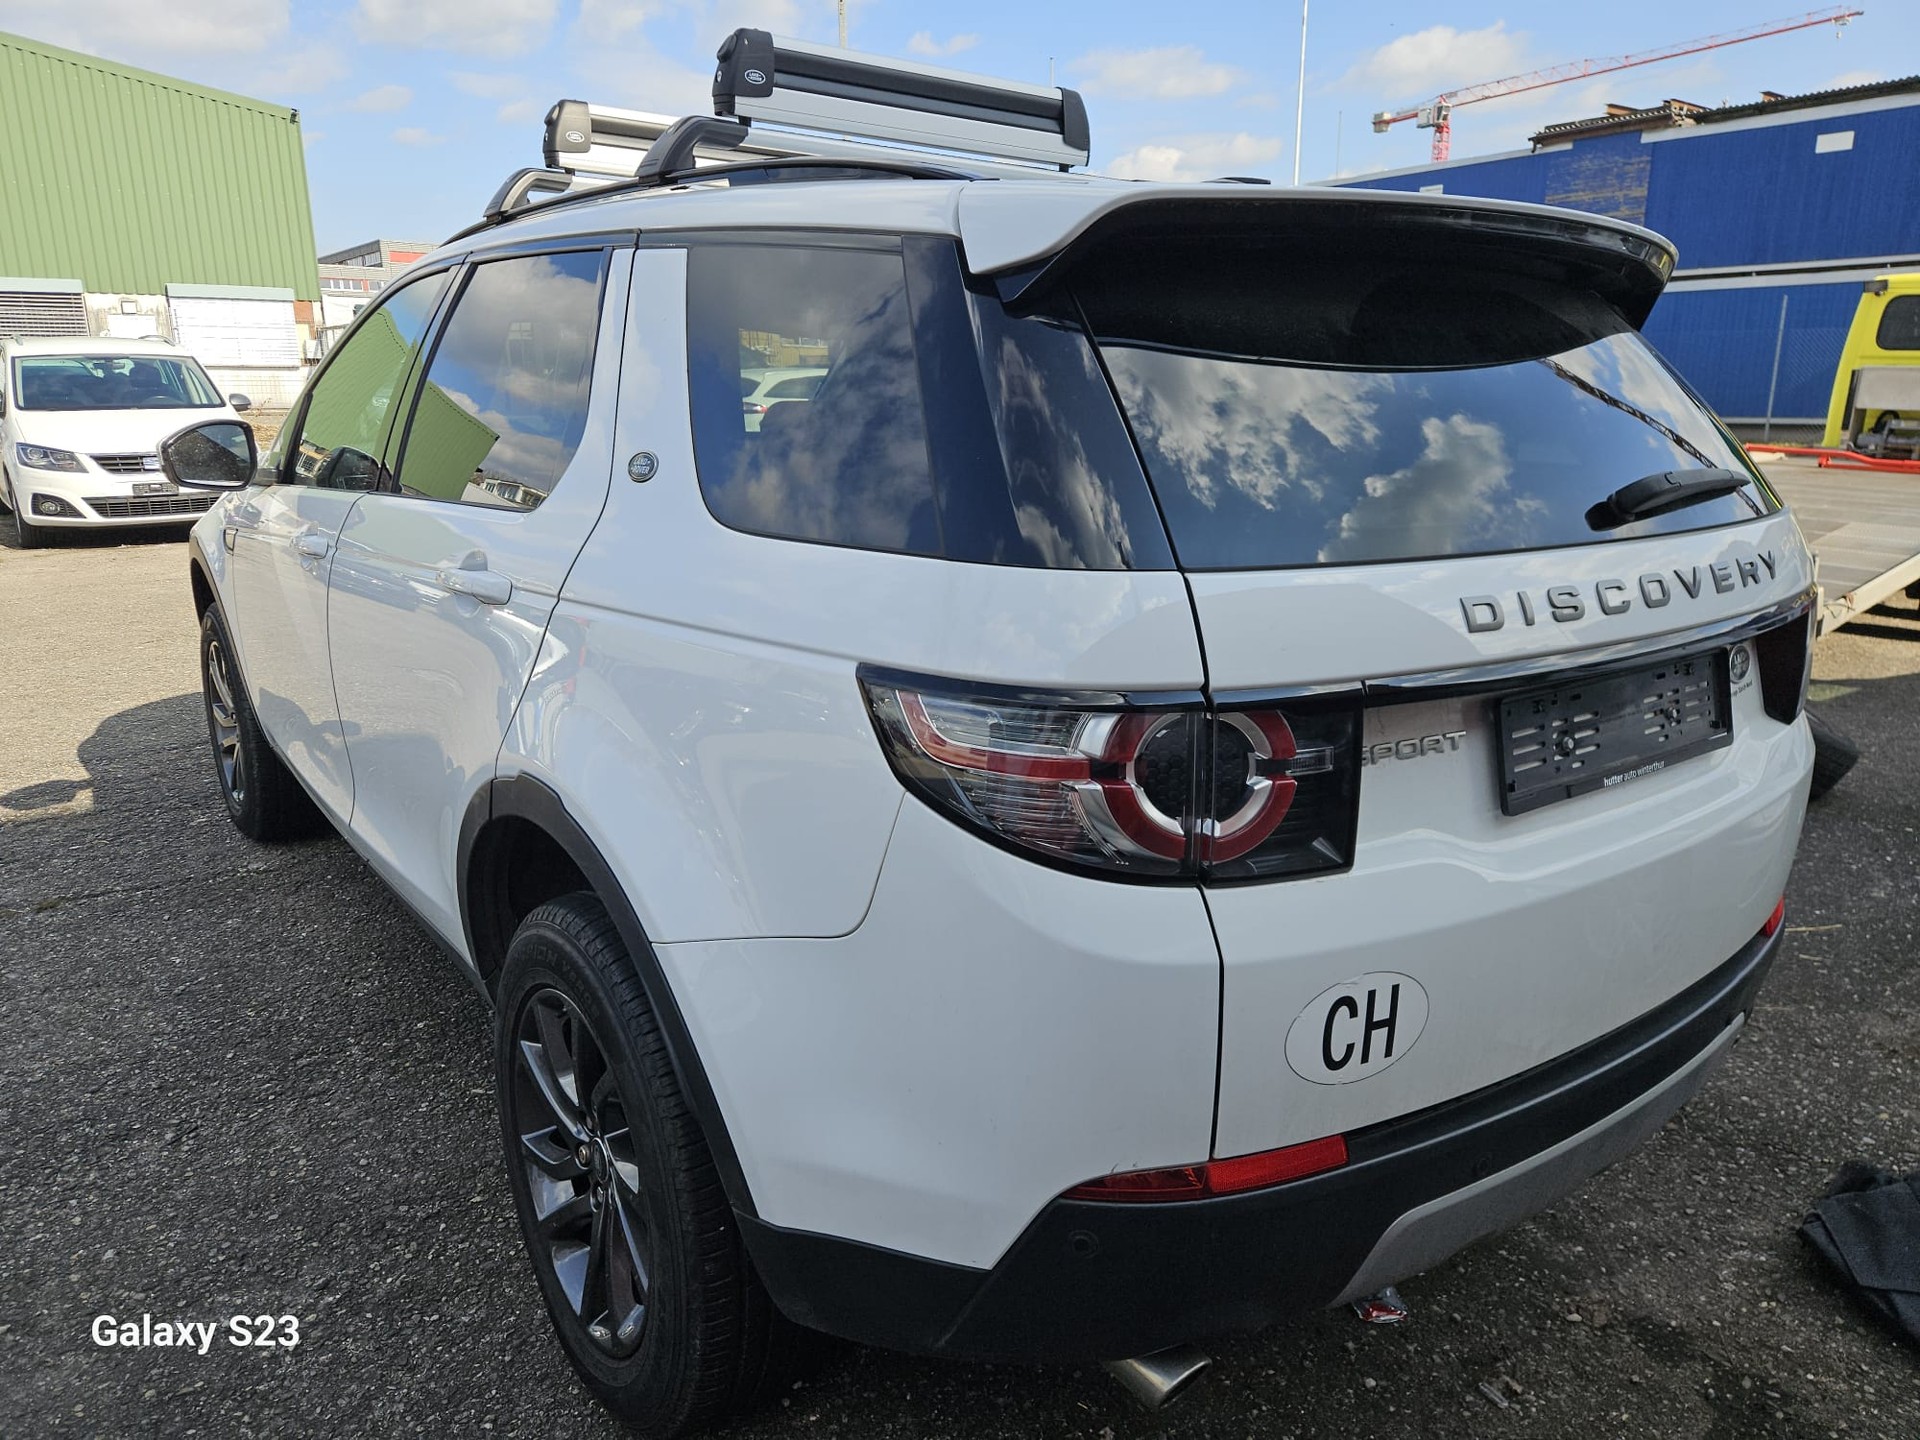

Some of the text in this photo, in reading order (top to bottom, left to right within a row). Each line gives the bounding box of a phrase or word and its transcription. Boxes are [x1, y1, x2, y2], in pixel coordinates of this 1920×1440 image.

[1459, 550, 1777, 633] DISCOVERY
[1624, 770, 1637, 781] auto
[1322, 983, 1400, 1072] CH
